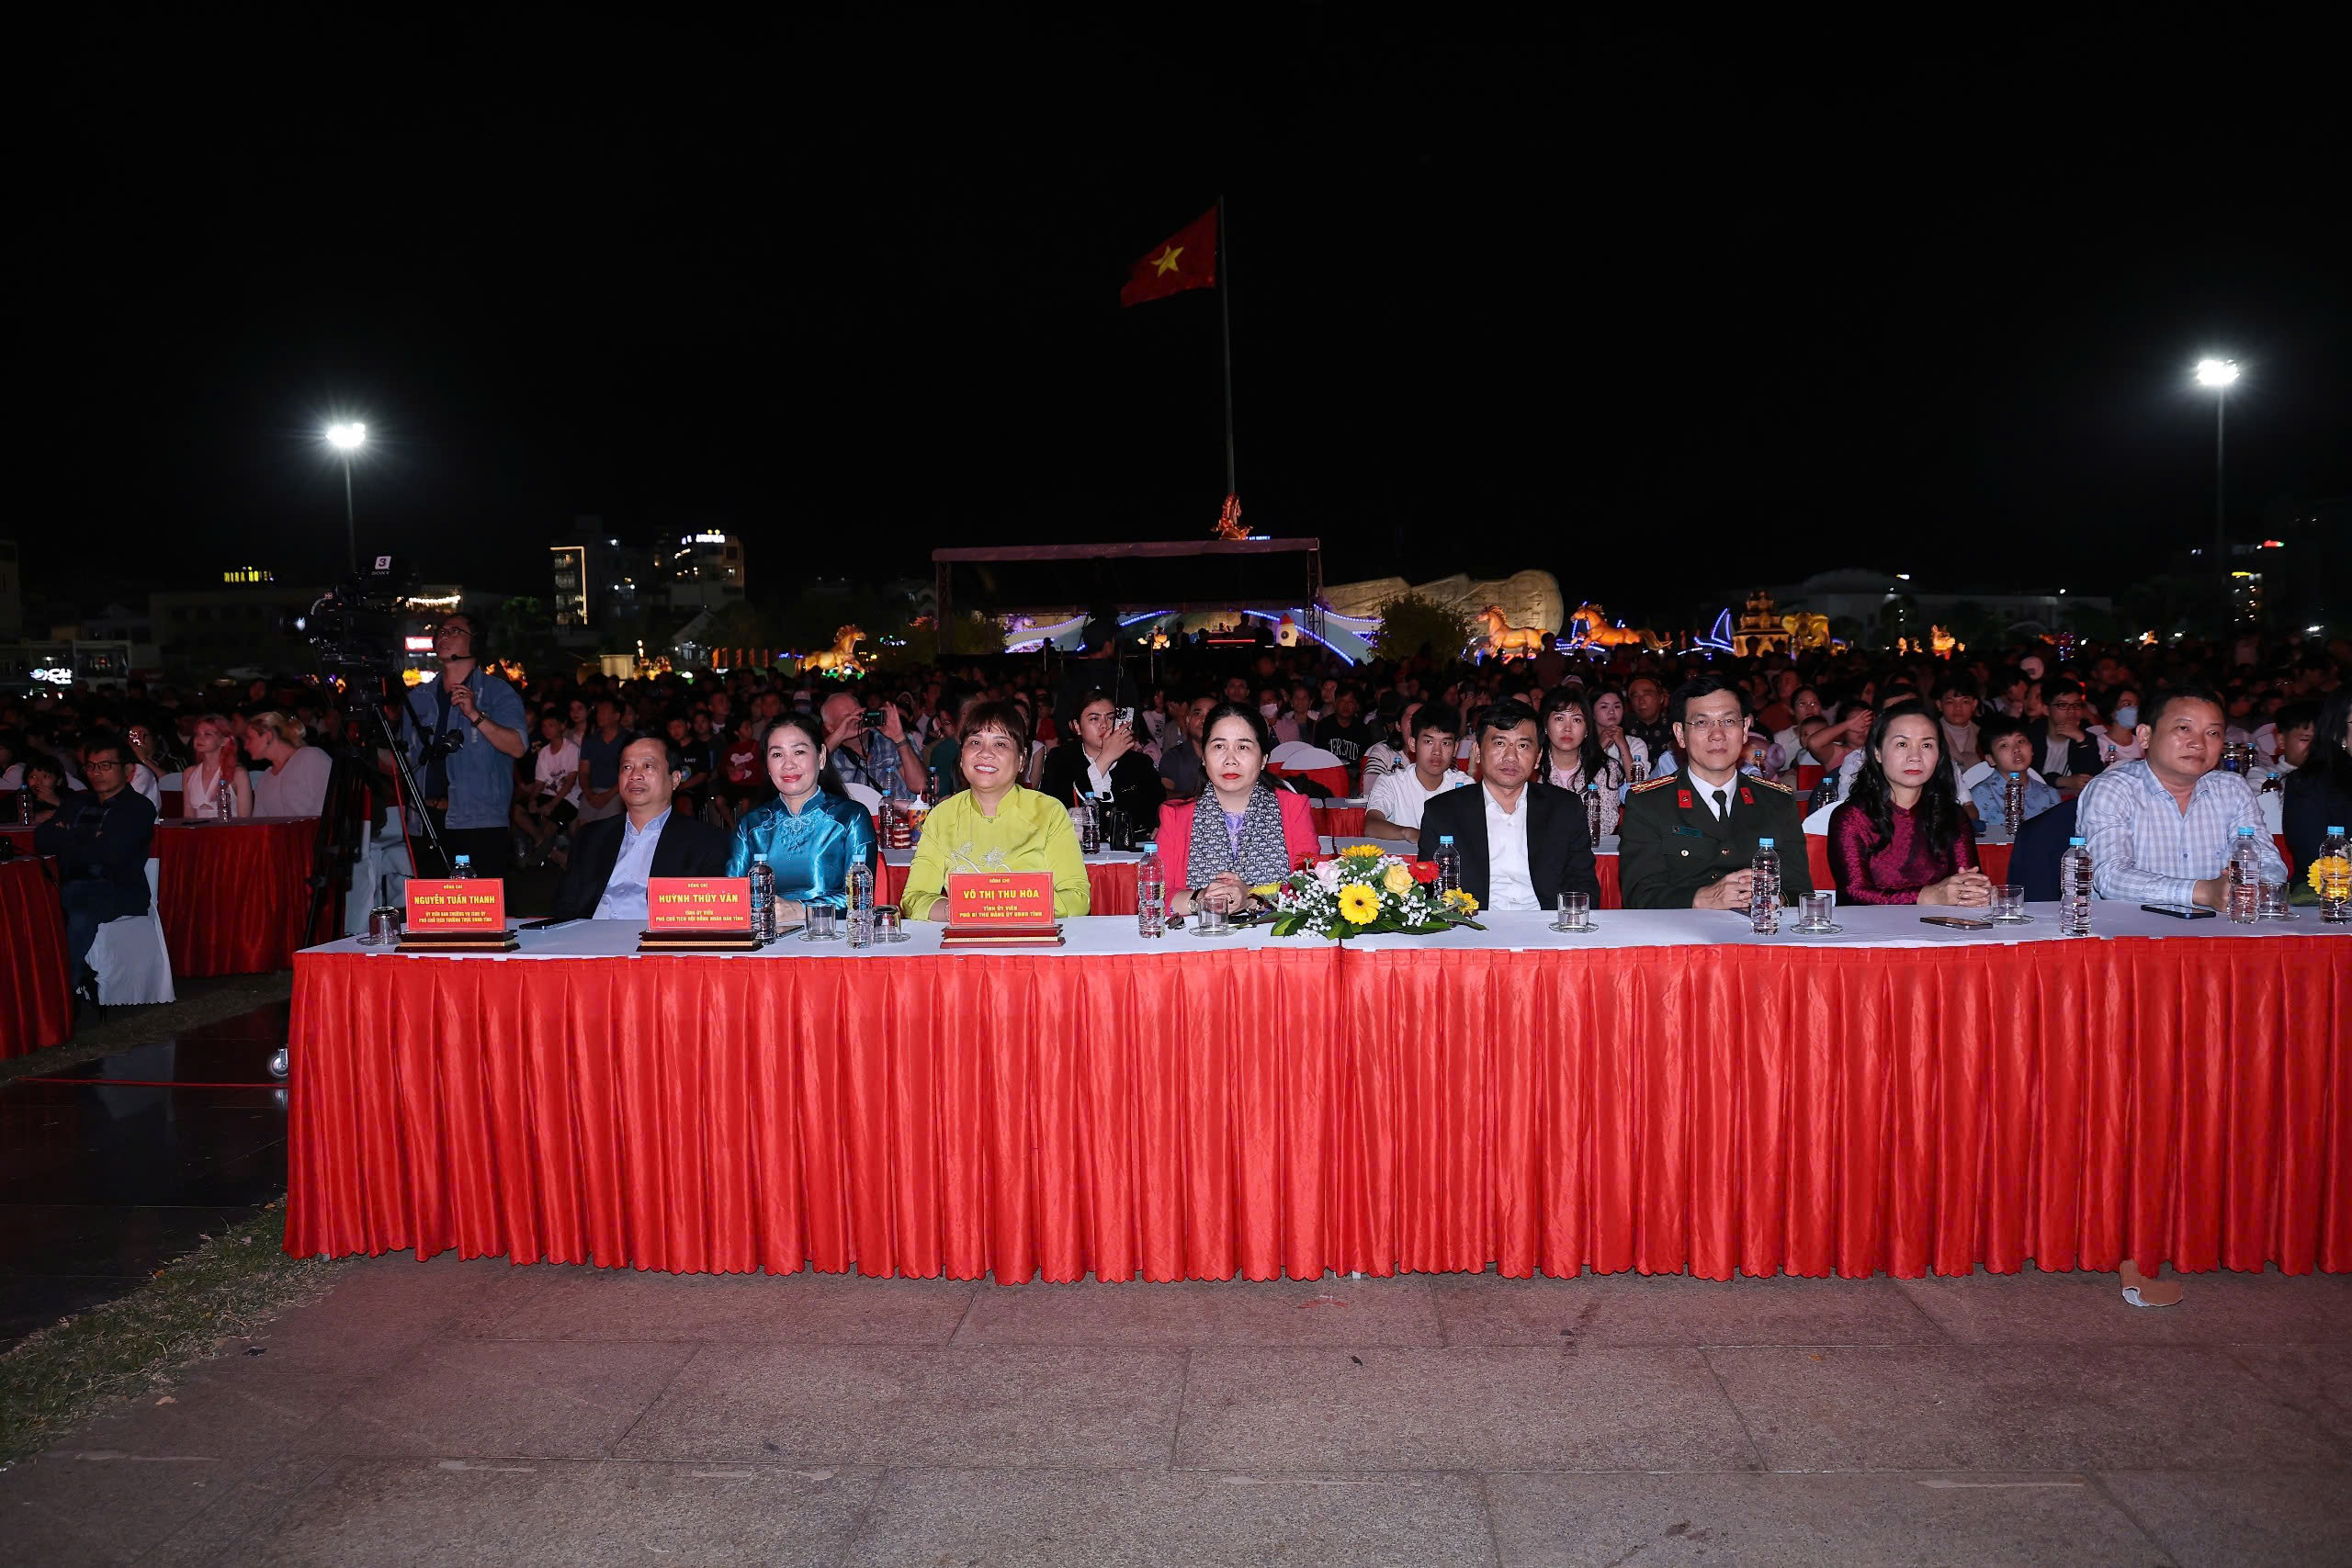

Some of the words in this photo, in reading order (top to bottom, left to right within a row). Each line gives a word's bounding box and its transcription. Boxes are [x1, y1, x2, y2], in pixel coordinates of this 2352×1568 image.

[378, 558, 387, 567] 3
[414, 894, 445, 904] NGUYỄN
[447, 894, 467, 904] TUẤN
[469, 896, 494, 904] THANH
[659, 893, 690, 903] HUỲNH
[693, 893, 717, 902] THÚY
[963, 889, 976, 899] VÕ
[979, 890, 995, 900] THỊ
[998, 890, 1016, 898] THU
[1020, 888, 1039, 897] HÒA
